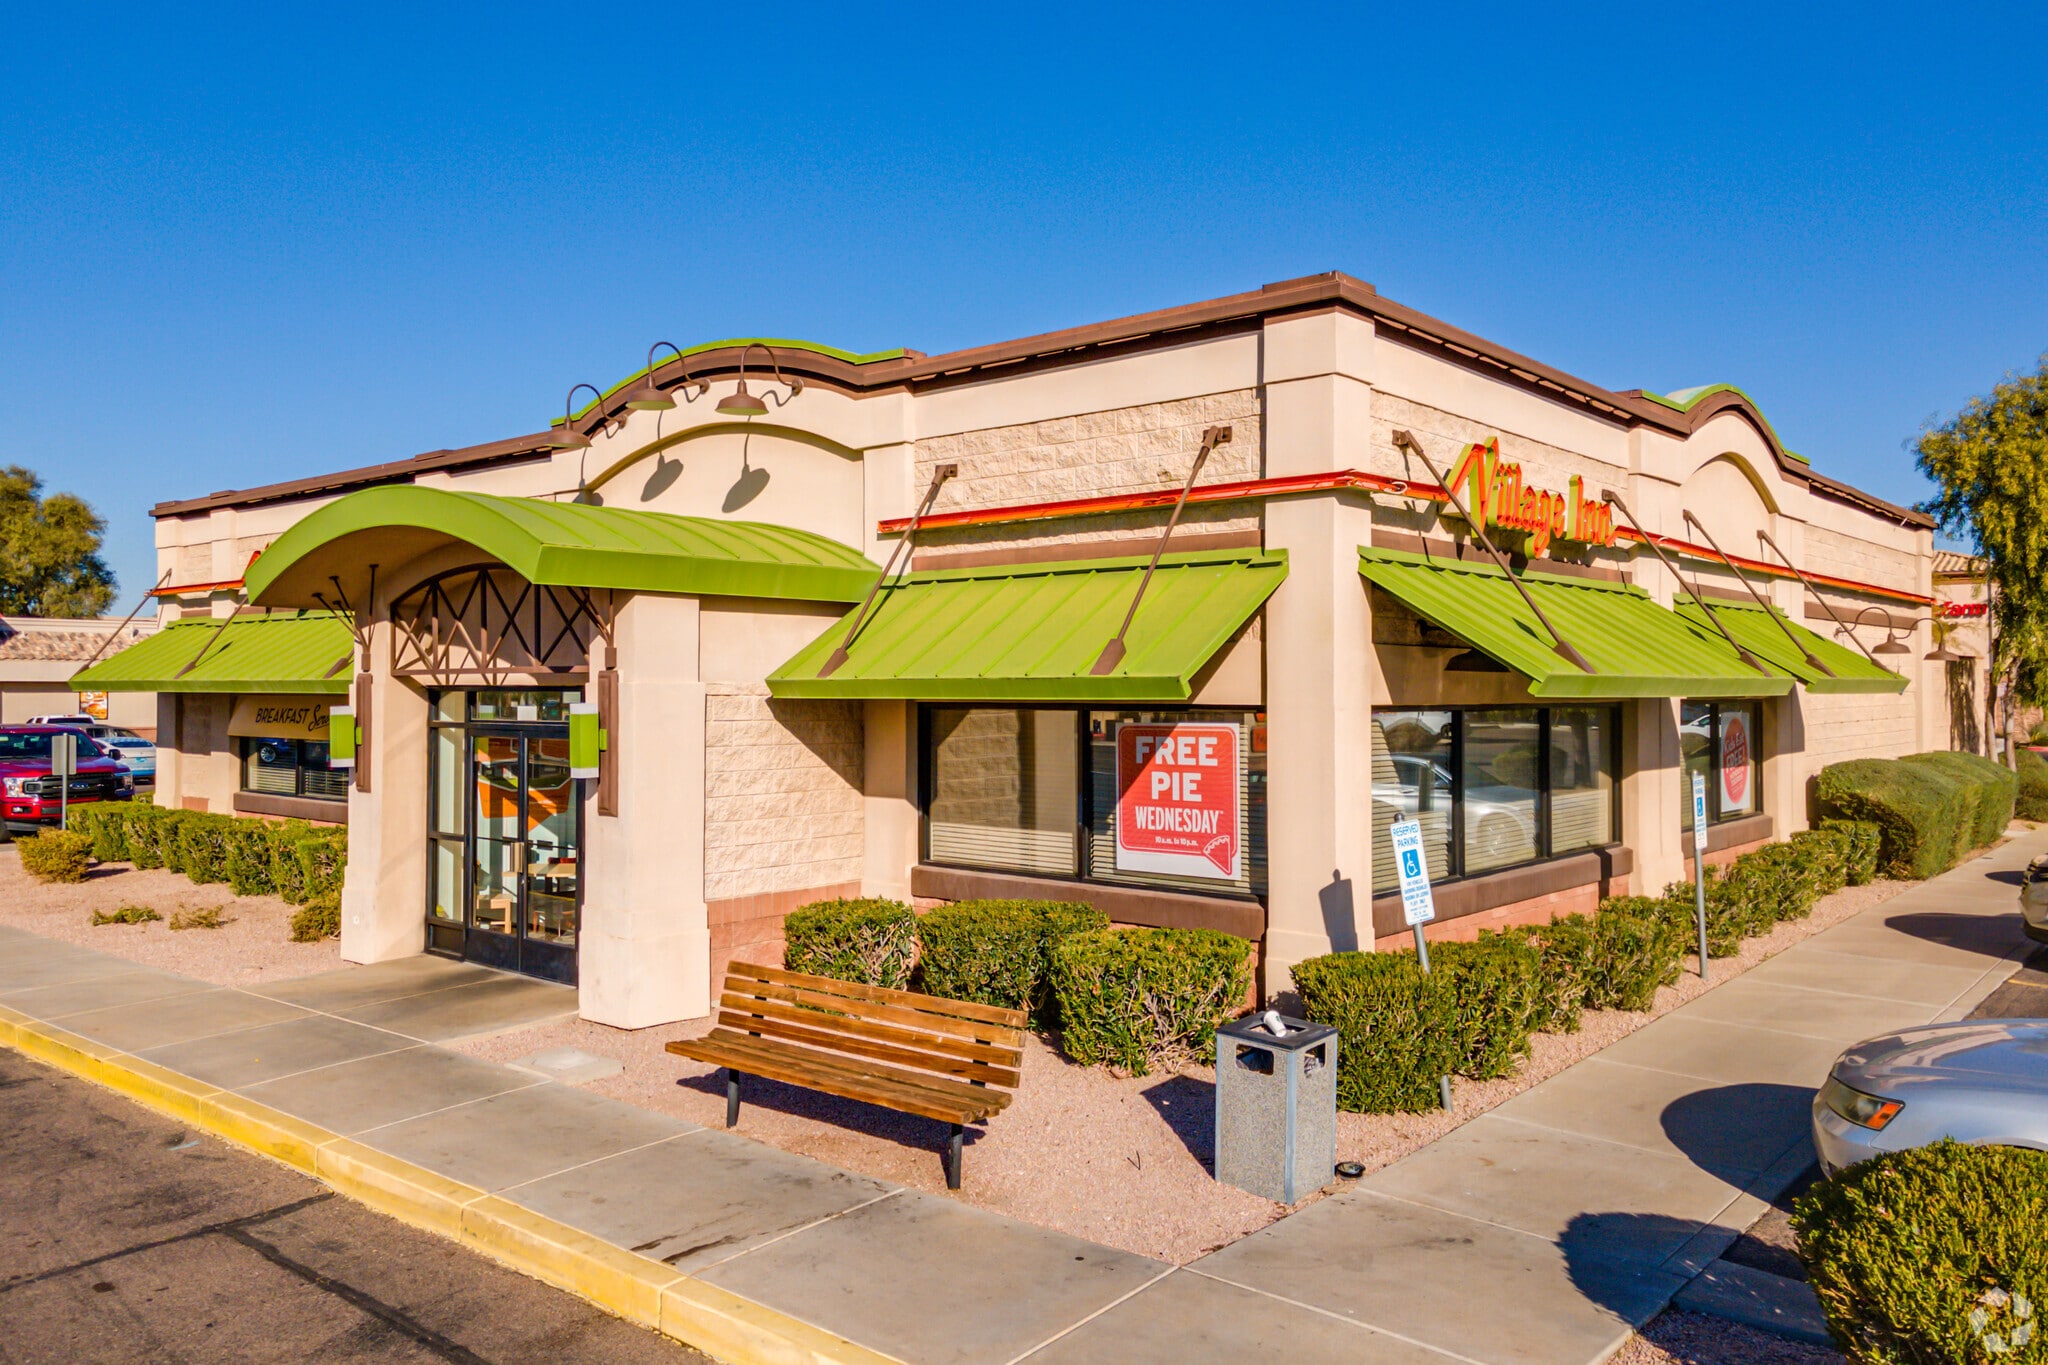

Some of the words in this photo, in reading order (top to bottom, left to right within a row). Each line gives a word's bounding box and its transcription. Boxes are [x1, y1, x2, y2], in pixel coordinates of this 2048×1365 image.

[1446, 436, 1566, 560] Village
[1565, 474, 1617, 548] Inn
[1941, 601, 1988, 617] Farm
[255, 708, 310, 724] BREAKFAST
[1135, 735, 1218, 767] FREE
[1151, 771, 1202, 802] PIE
[1392, 823, 1419, 837] RESERVED
[1397, 836, 1419, 849] PARKING
